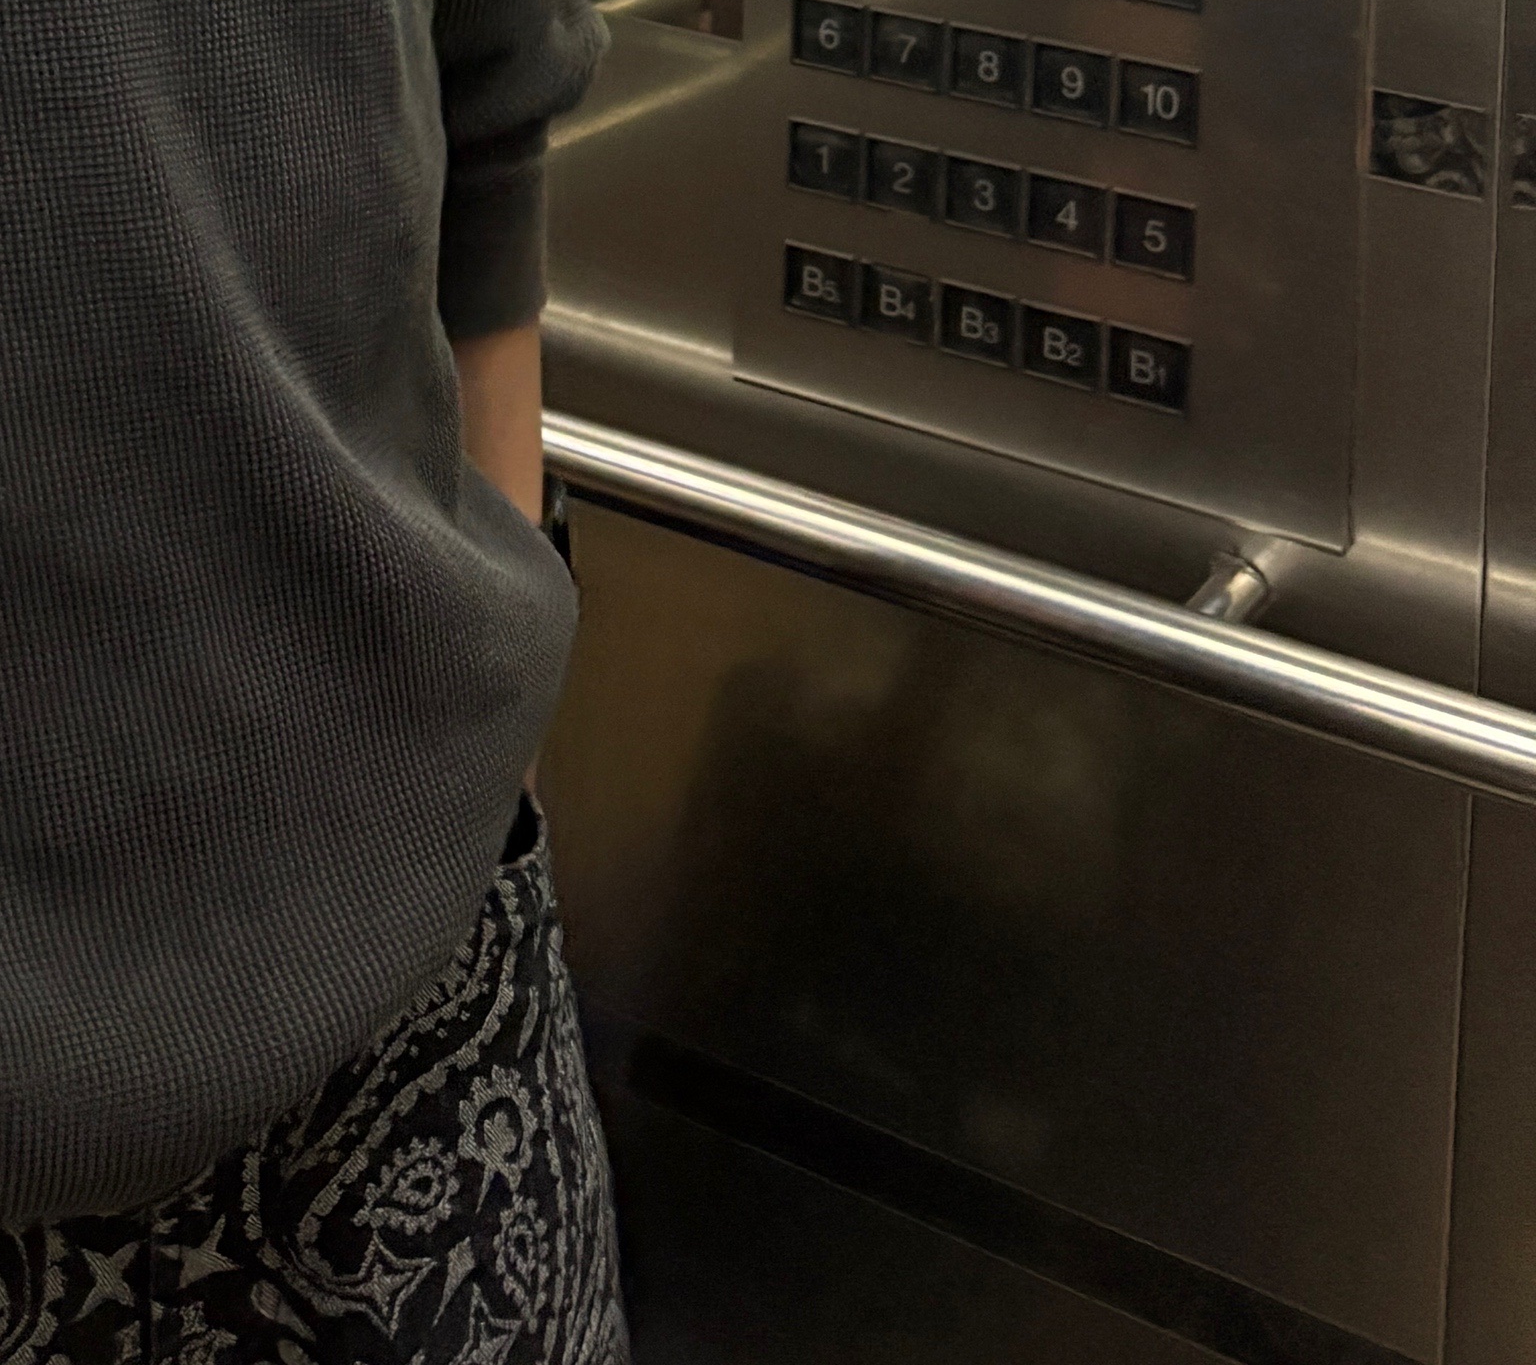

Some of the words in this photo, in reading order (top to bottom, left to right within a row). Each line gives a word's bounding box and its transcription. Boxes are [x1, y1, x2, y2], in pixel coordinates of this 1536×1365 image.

[819, 19, 839, 49] 6
[899, 33, 916, 63] 7
[977, 50, 999, 82] 8
[1061, 66, 1085, 99] 9
[1142, 83, 1180, 121] 10
[818, 146, 830, 174] 1
[893, 163, 914, 193] 2
[974, 180, 995, 211] 3
[1055, 201, 1078, 232] 4
[1144, 221, 1166, 252] 5
[961, 307, 999, 344] B3
[1043, 327, 1083, 366] B2
